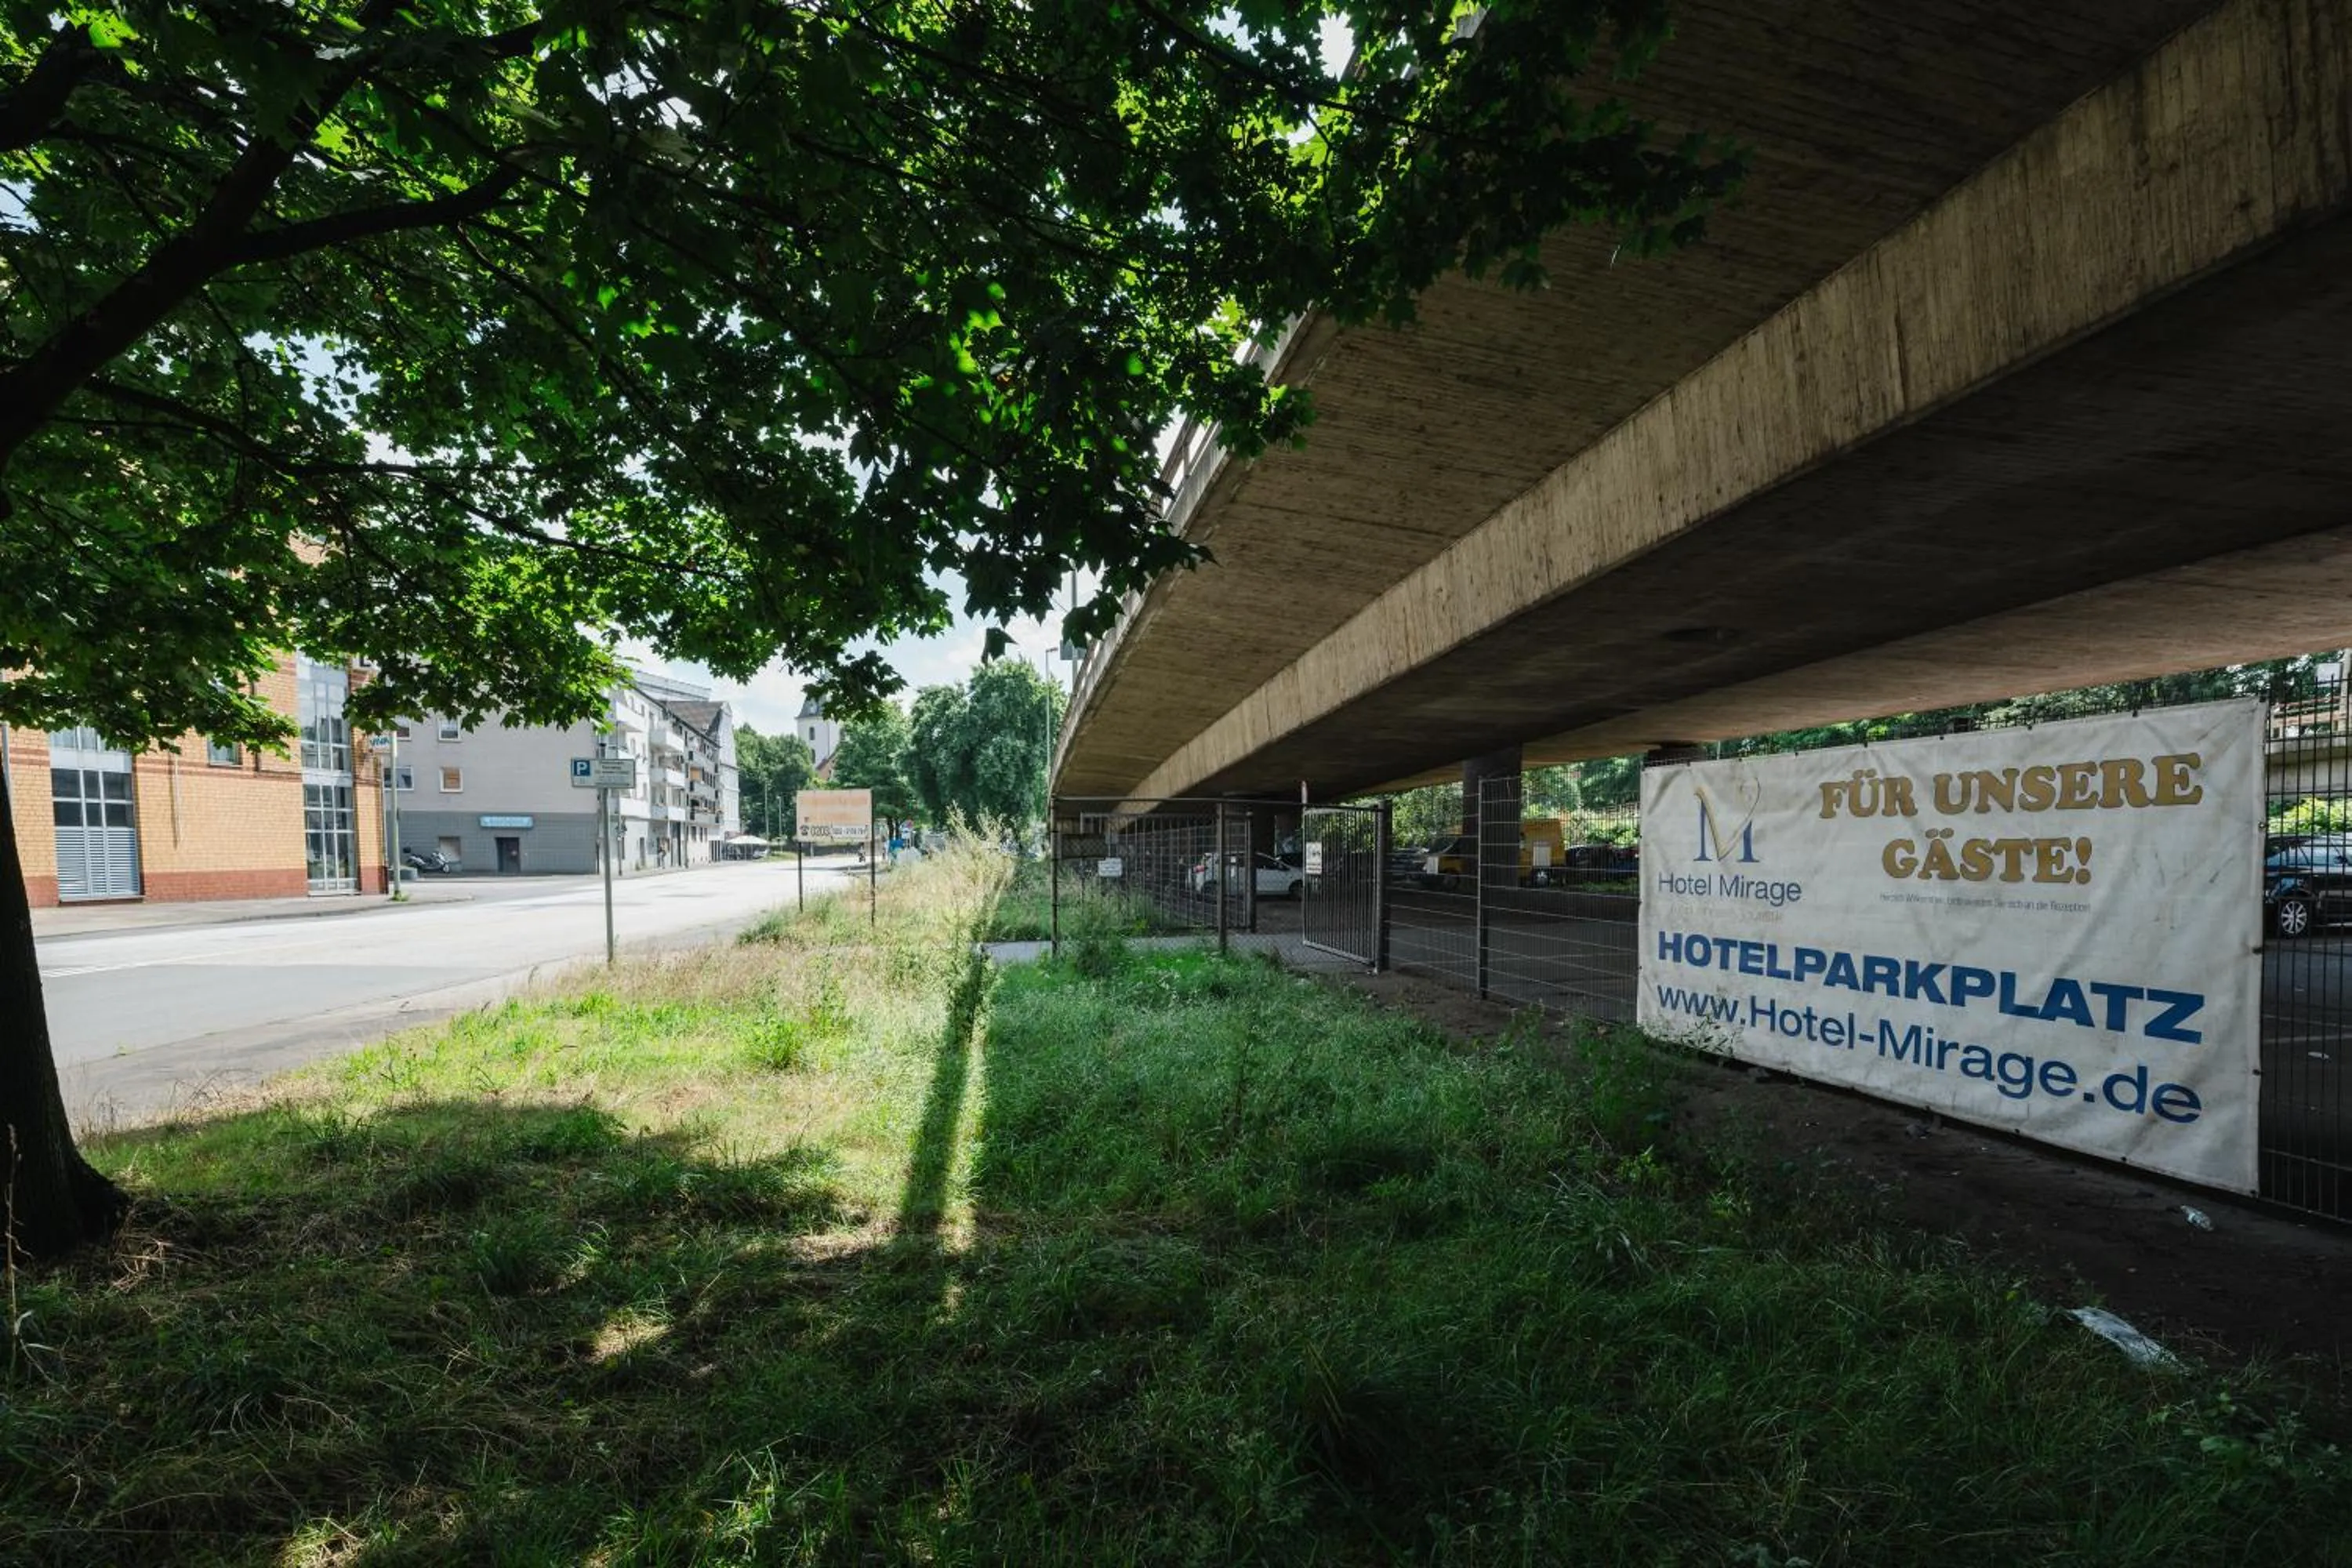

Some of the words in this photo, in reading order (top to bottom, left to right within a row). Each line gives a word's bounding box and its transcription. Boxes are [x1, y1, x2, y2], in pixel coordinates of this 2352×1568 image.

[576, 761, 587, 775] P
[1819, 768, 1918, 818] FÜR
[1932, 752, 2204, 815] UNSERE
[1882, 828, 2093, 885] GÄSTE!
[1658, 872, 1711, 897] Hotel
[1719, 874, 1802, 907] Mirage
[1657, 931, 2205, 1044] HOTELPARKPLATZ
[1657, 984, 2202, 1123] www.Hotel-Mirage.de
